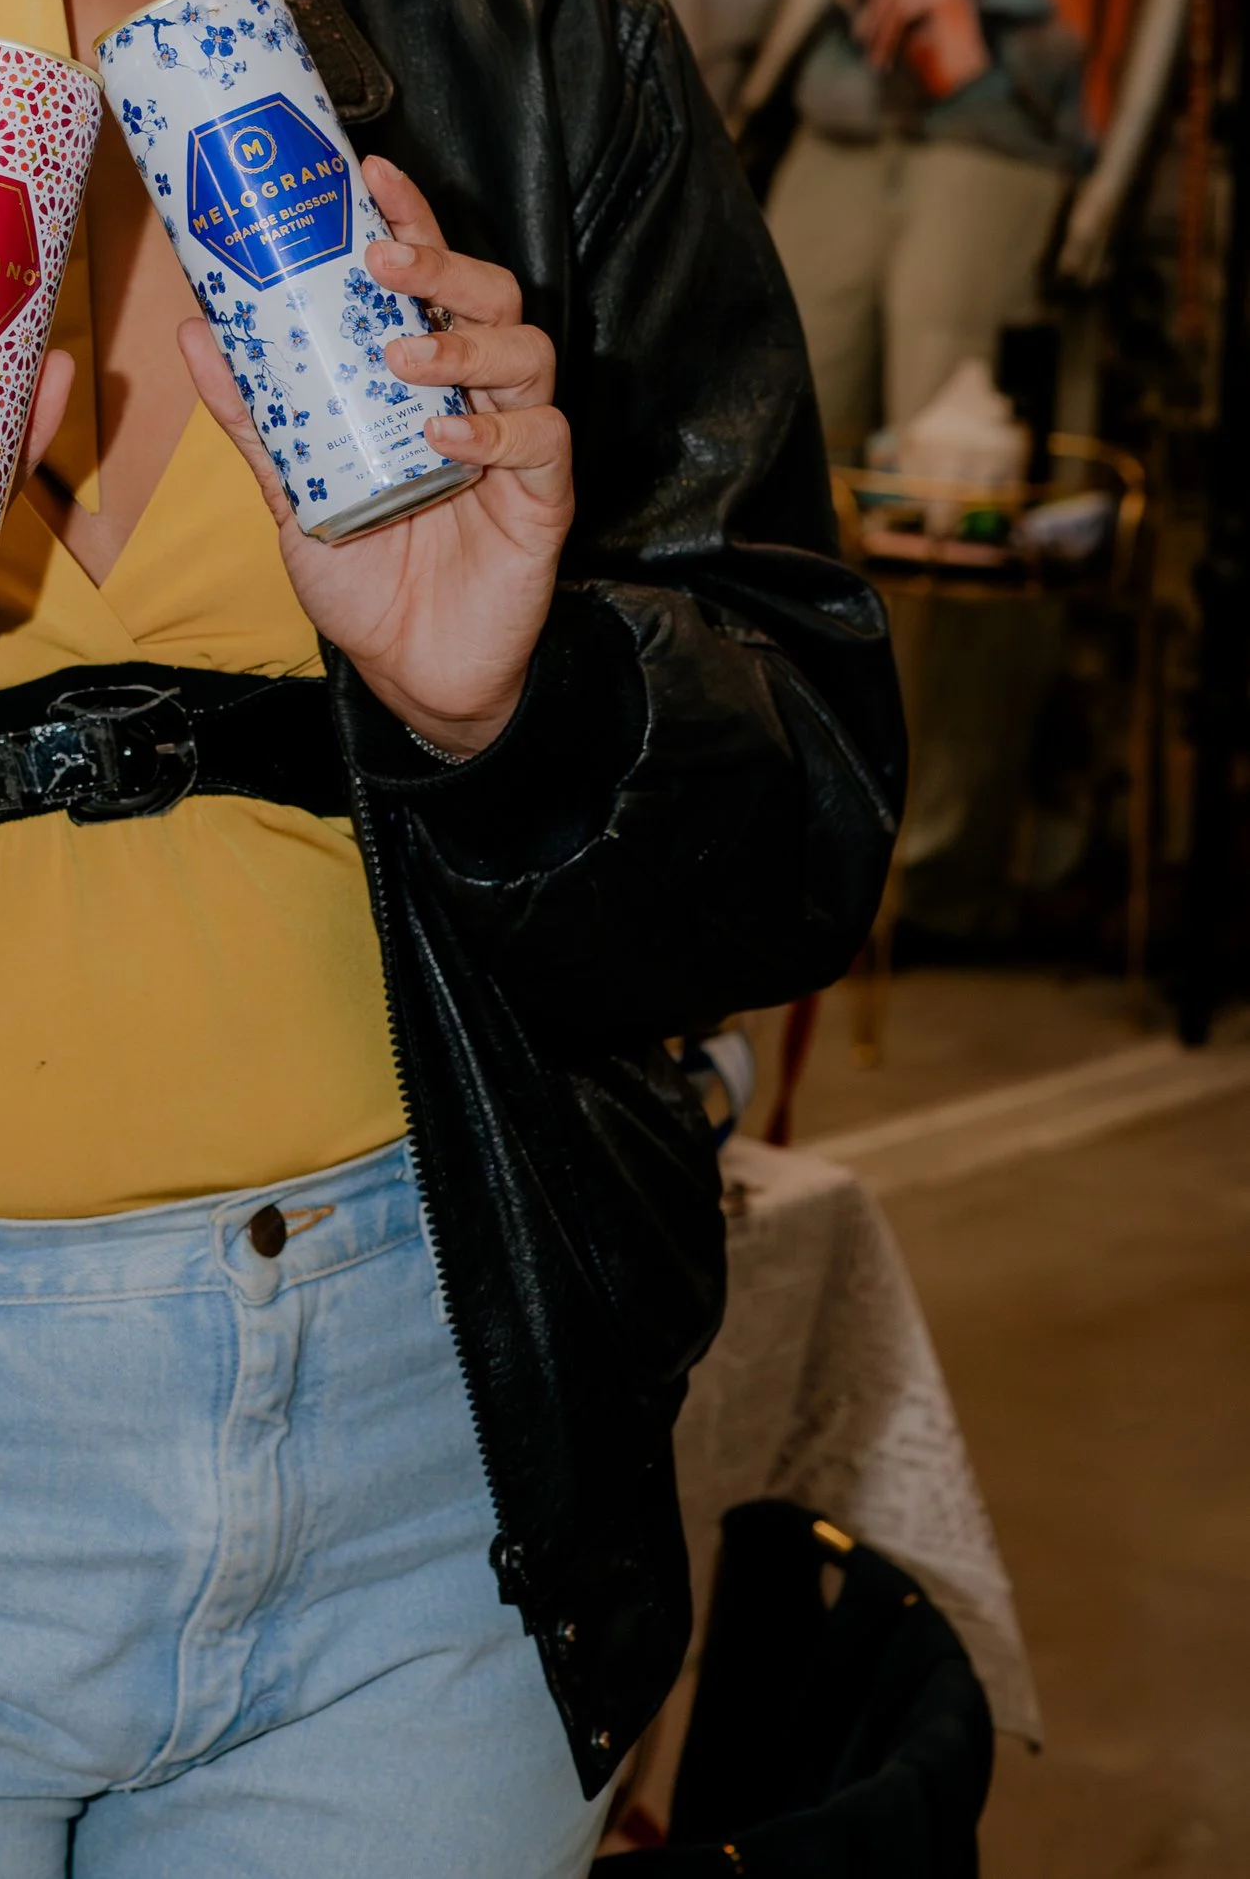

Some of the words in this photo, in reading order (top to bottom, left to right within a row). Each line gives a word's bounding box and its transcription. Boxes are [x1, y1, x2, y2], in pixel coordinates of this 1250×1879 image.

[241, 138, 265, 162] M
[192, 157, 345, 234] MELOGRANO
[224, 213, 279, 246] ORANGE
[279, 190, 338, 221] BLOSSOM
[259, 213, 315, 246] MARTINI
[326, 433, 355, 451] BLUE
[357, 414, 395, 436] AGAVE
[396, 402, 425, 419] WINE
